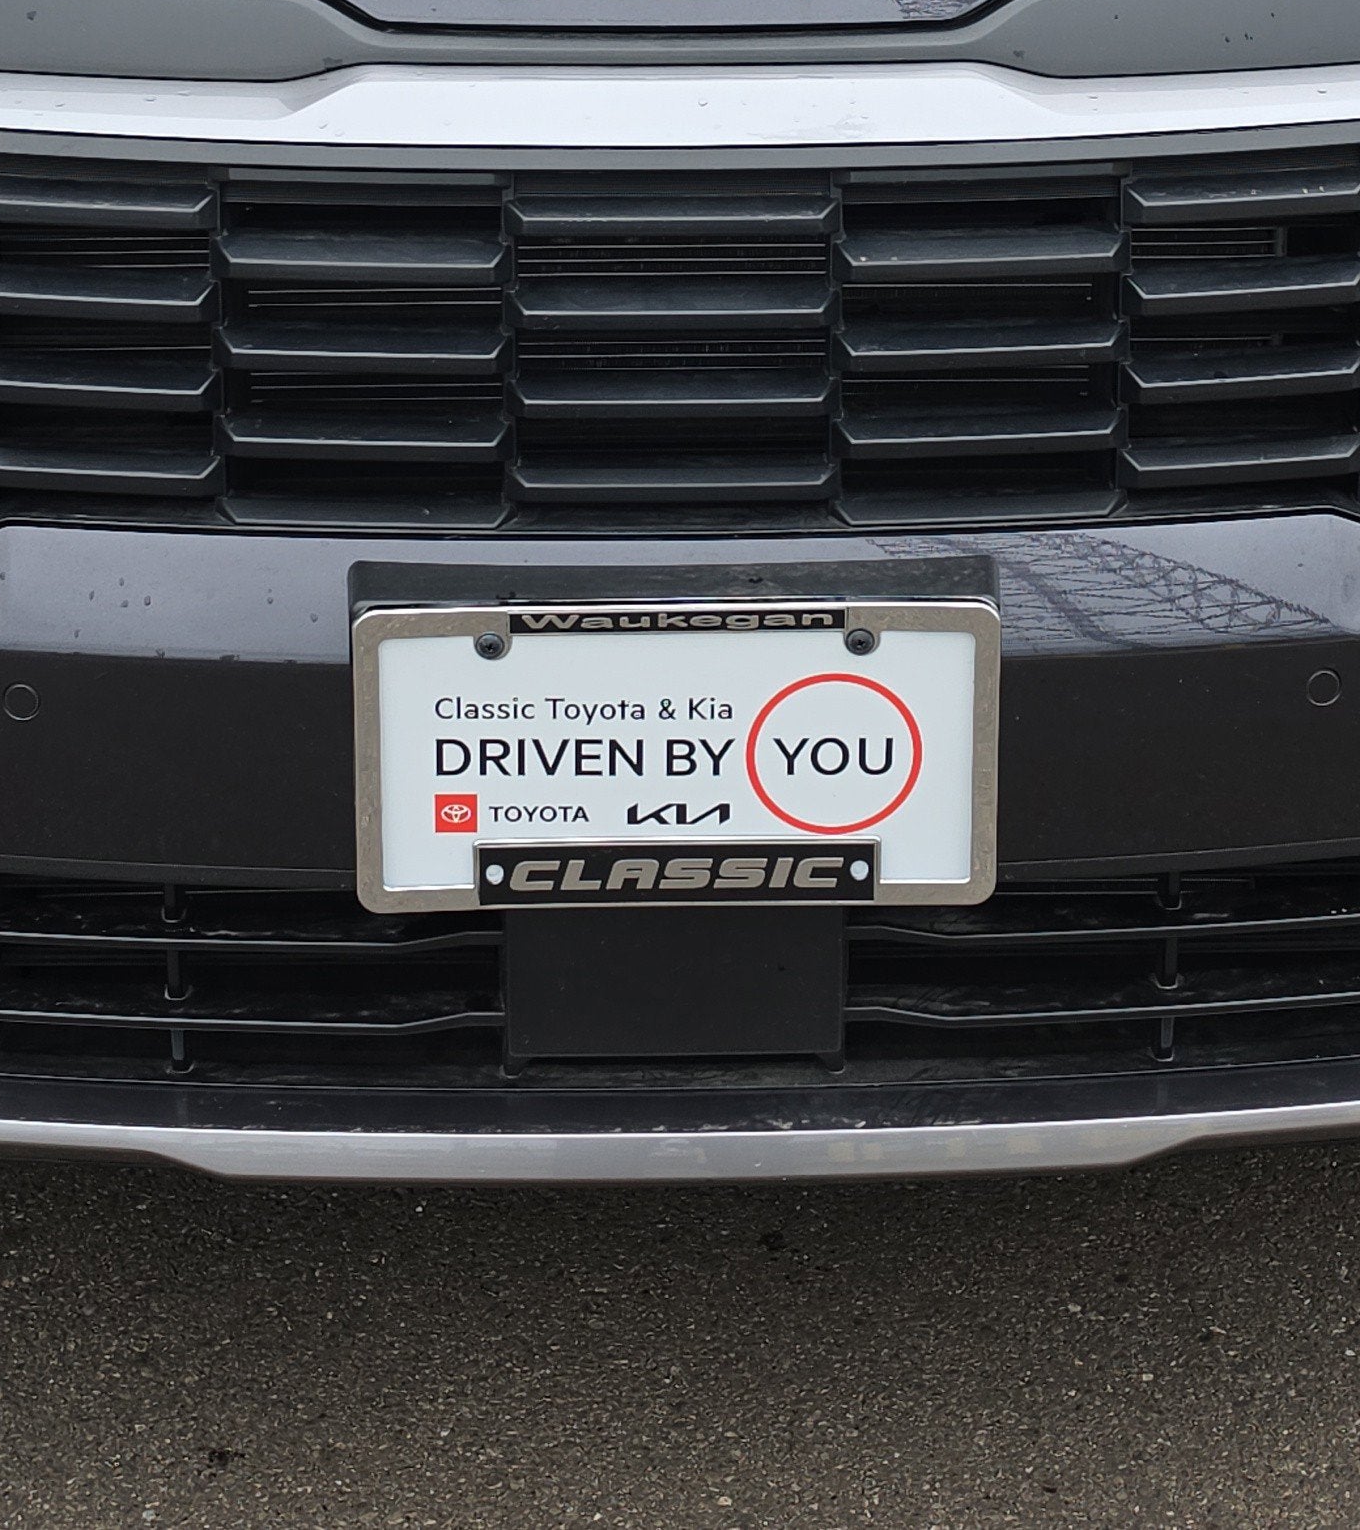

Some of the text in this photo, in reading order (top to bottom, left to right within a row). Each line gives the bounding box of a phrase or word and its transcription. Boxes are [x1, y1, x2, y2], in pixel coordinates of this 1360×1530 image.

[521, 611, 834, 630] Waukegan
[434, 696, 733, 726] Classic Toyota & Kia
[435, 737, 894, 777] DRIVEN BY YOU
[488, 802, 731, 825] TOYOTA KIA
[509, 856, 844, 891] CLASSIC
